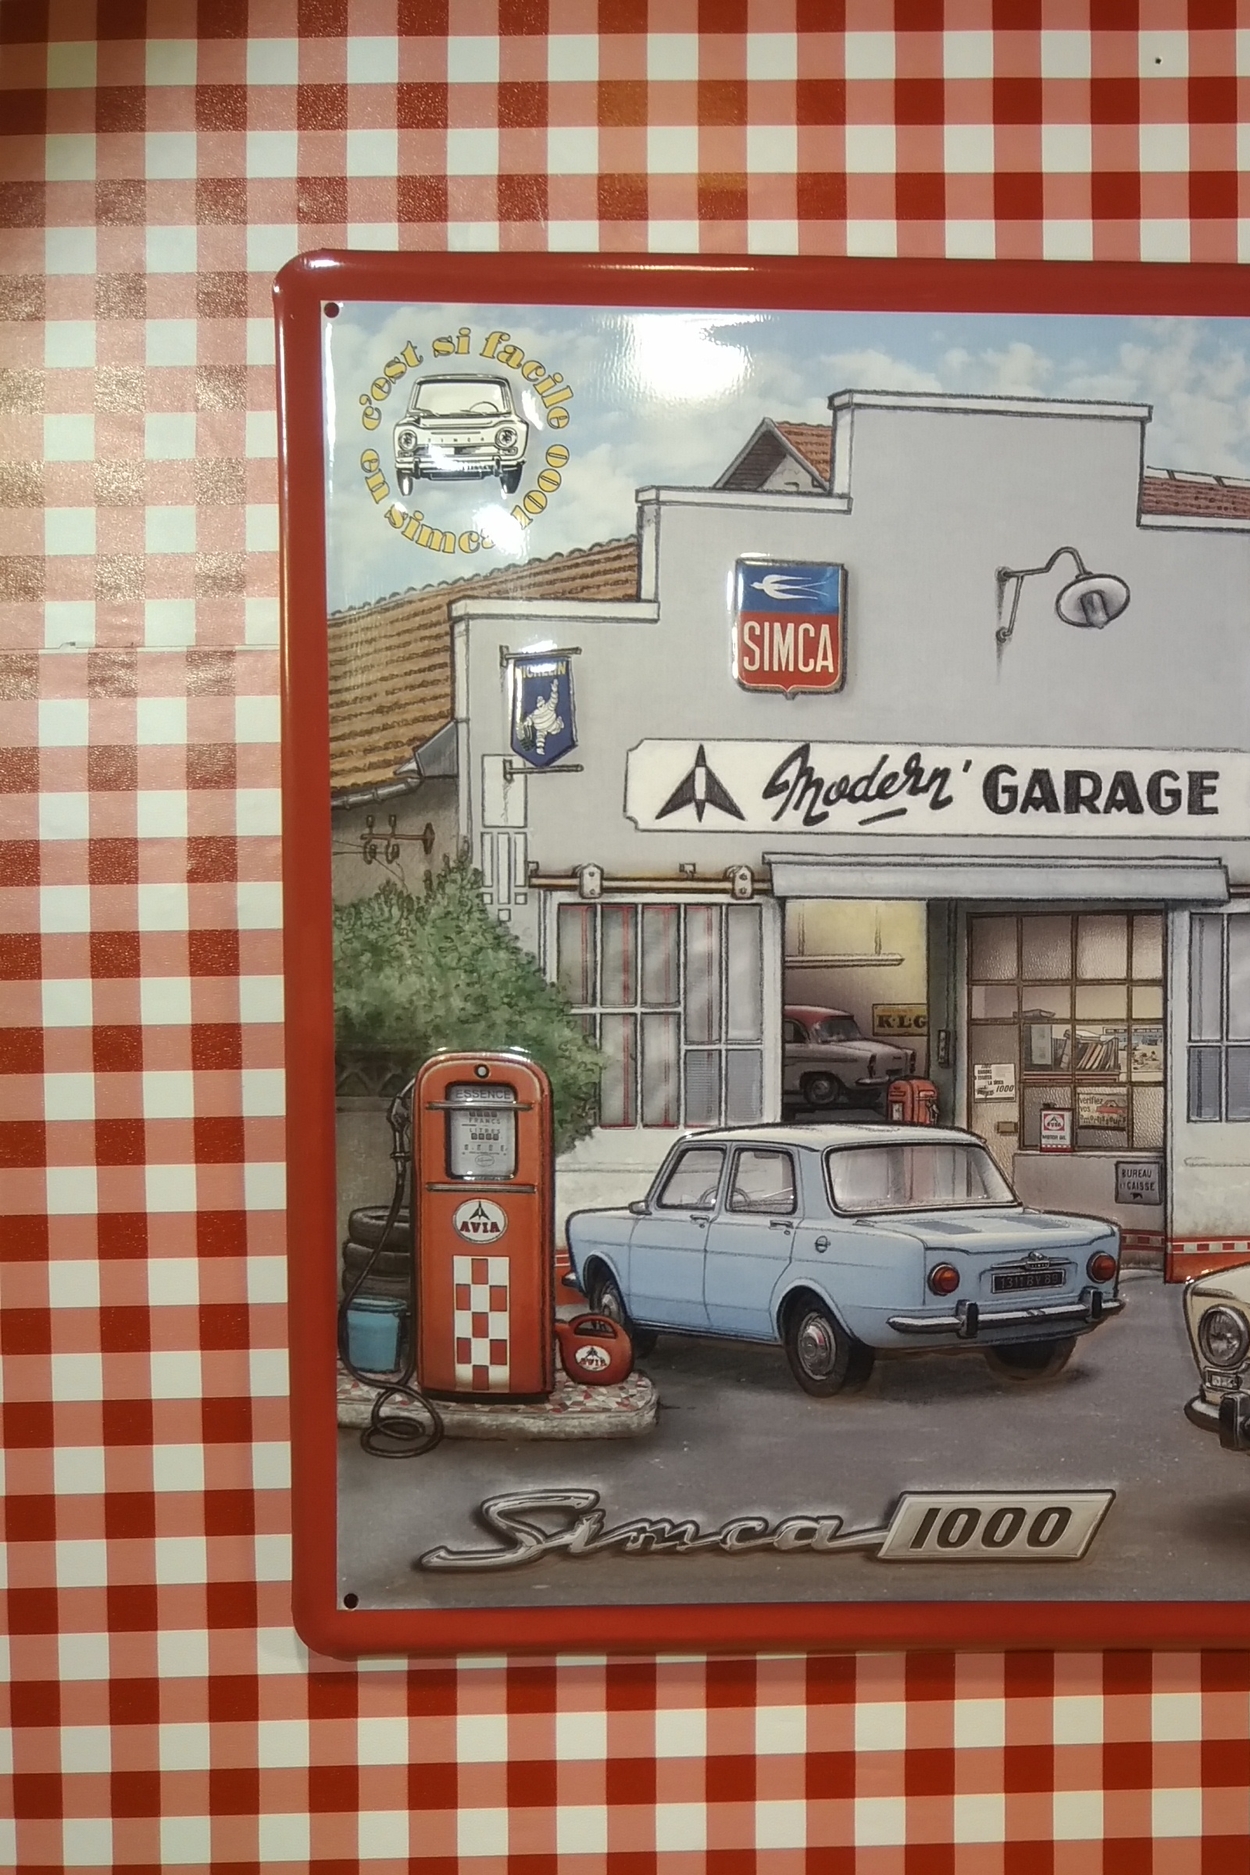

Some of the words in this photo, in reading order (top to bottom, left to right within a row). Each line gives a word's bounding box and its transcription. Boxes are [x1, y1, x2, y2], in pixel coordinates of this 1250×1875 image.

[432, 327, 471, 357] si
[480, 331, 573, 429] facile
[360, 449, 390, 504] en
[510, 444, 570, 529] 1000
[743, 621, 835, 673] SIMCA
[983, 769, 1220, 815] GARAGE
[455, 1090, 511, 1099] ESSENCE
[1122, 1169, 1151, 1178] BUREAU
[1127, 1182, 1155, 1191] CAISSE
[459, 1221, 501, 1234] AVIA
[413, 1488, 890, 1572] Simca
[909, 1507, 1074, 1550] 1000
